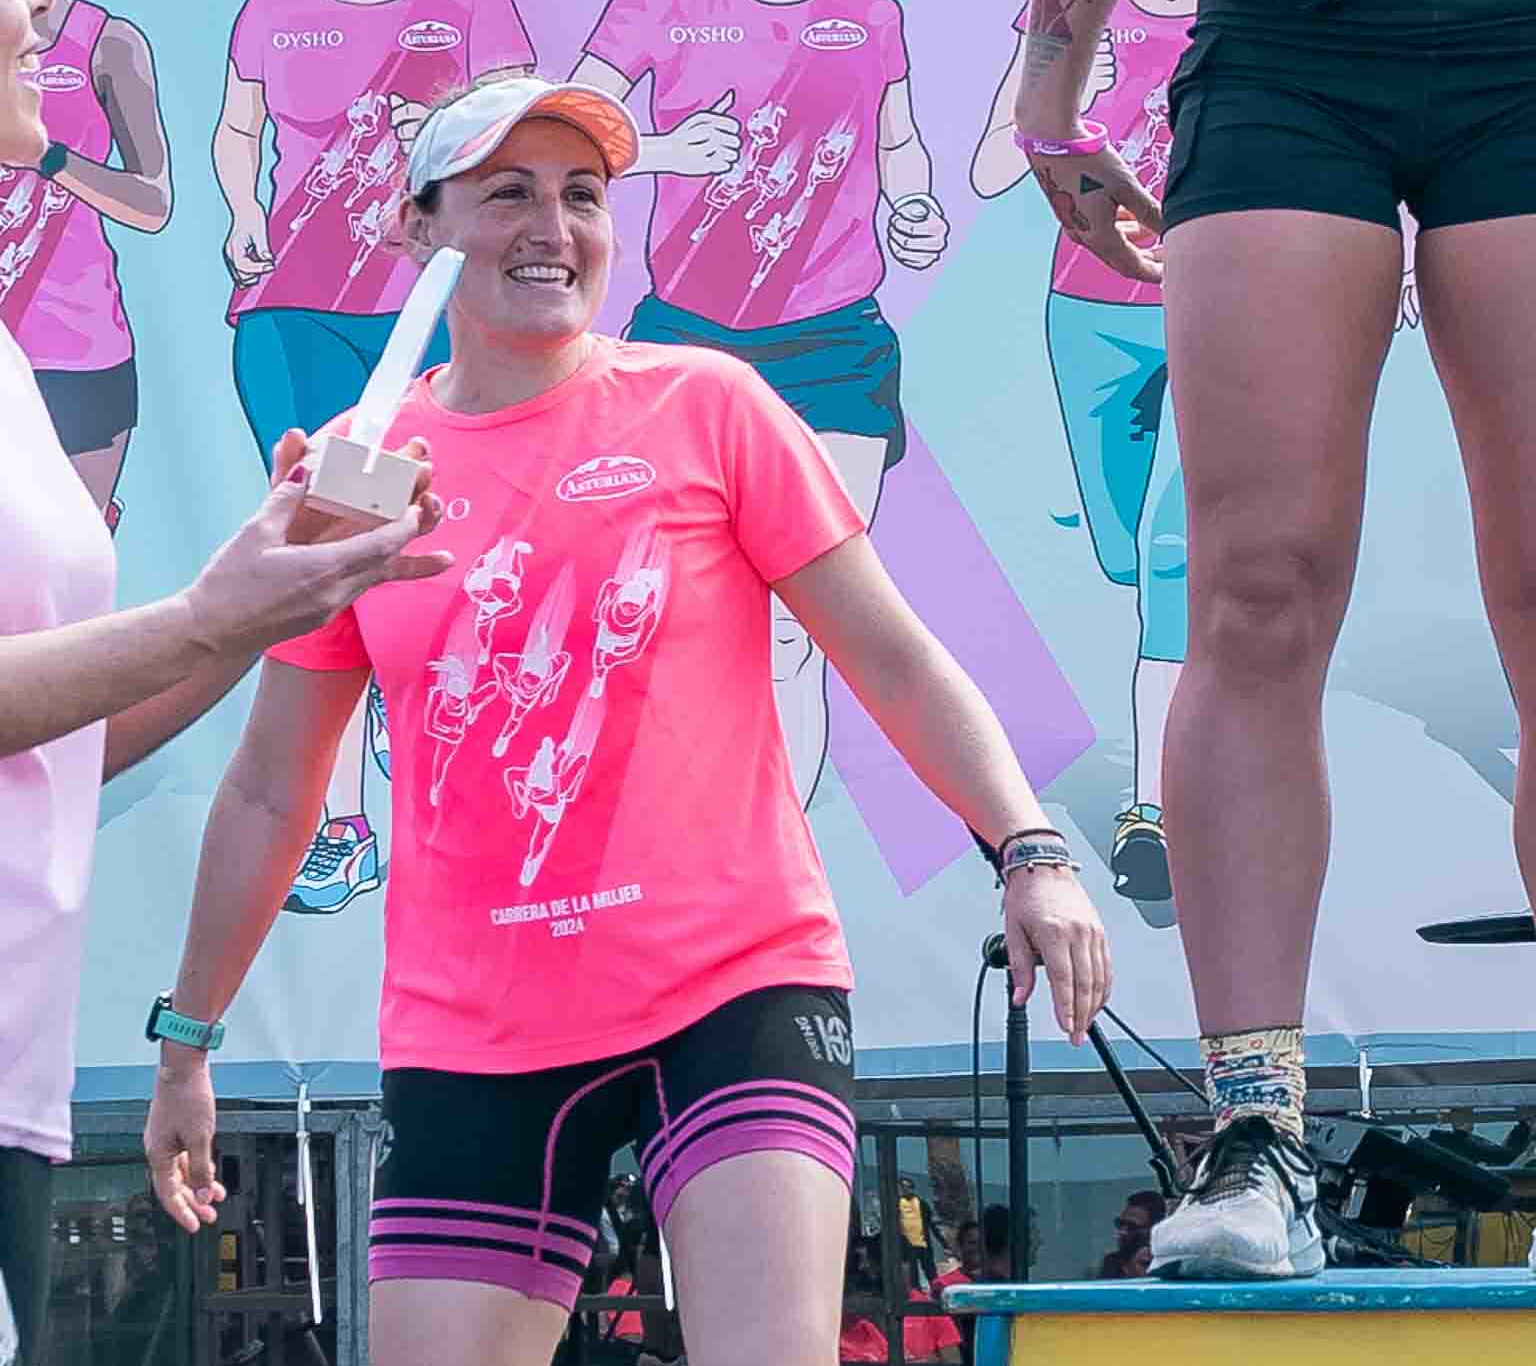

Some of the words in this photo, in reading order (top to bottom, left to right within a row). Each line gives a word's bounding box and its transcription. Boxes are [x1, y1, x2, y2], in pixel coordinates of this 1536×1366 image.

[272, 30, 344, 51] OYSHO
[669, 26, 744, 45] OYSHO
[489, 902, 550, 925] CARRERA
[550, 898, 570, 918] DE
[571, 895, 591, 915] LA
[592, 884, 644, 910] MUJER
[550, 917, 585, 938] 2024
